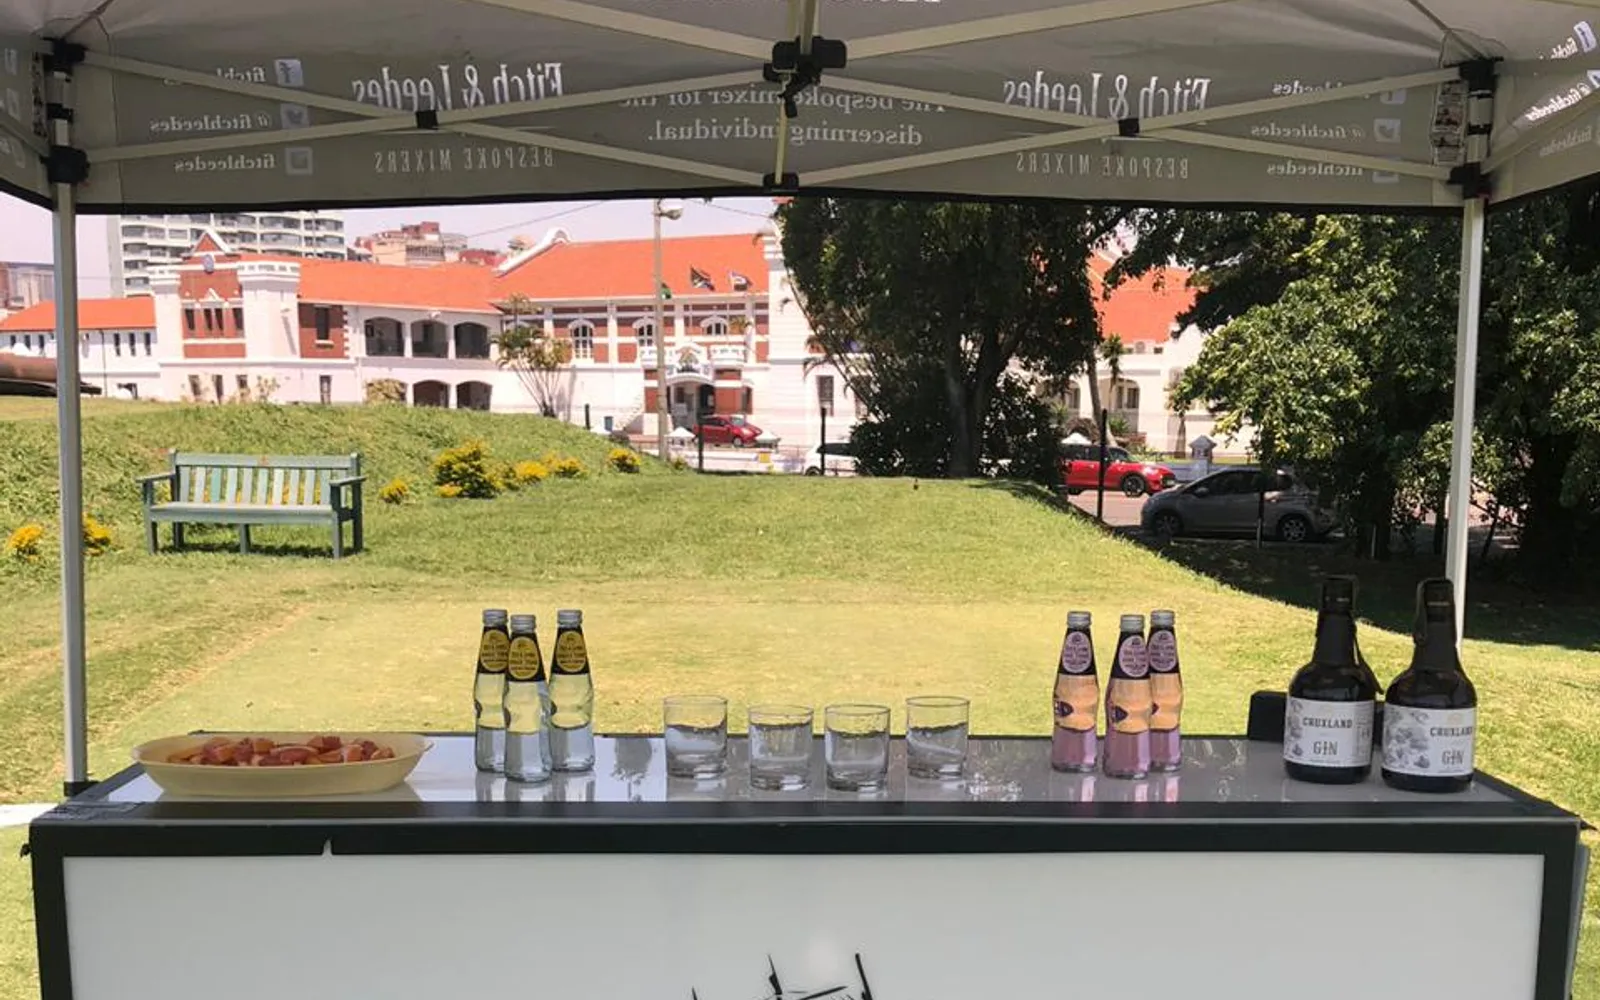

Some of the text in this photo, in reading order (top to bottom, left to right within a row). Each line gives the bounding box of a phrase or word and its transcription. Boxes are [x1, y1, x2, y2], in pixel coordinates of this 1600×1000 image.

[1302, 716, 1354, 729] CRUXLAND
[1312, 740, 1338, 756] GIN
[1441, 749, 1465, 766] GIN
